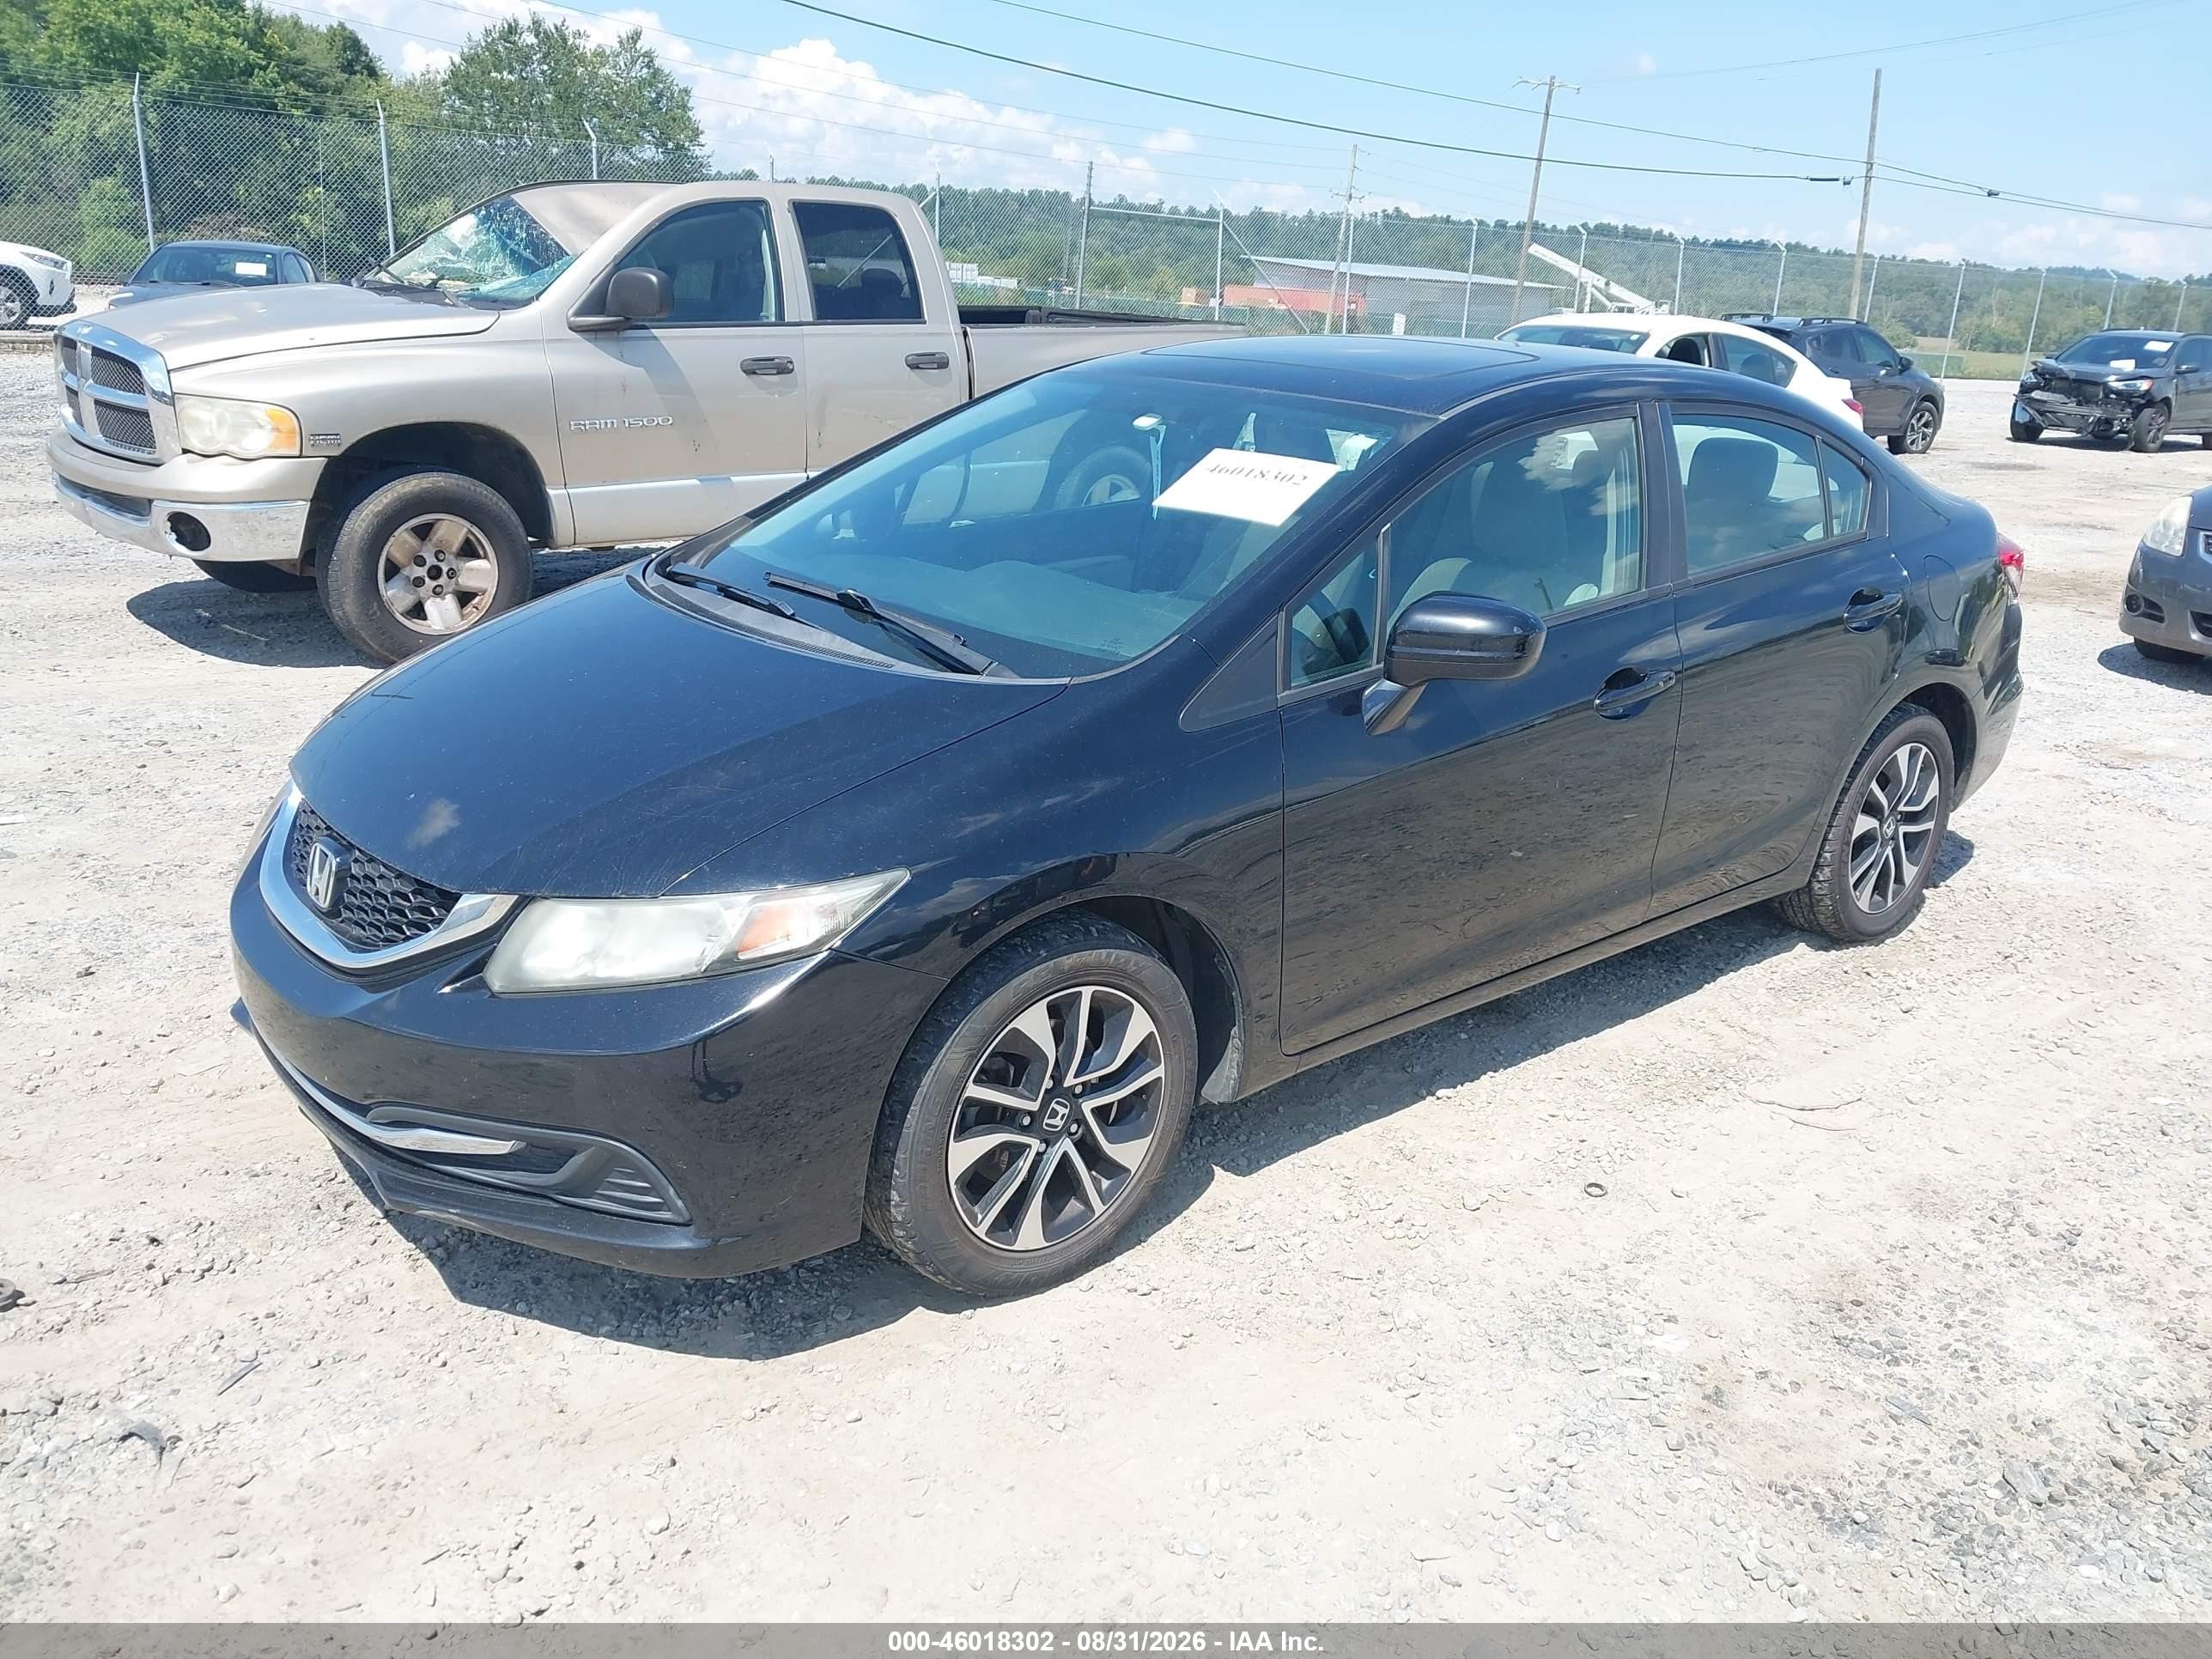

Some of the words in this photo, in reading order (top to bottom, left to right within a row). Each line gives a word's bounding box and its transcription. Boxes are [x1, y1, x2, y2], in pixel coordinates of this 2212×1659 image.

[570, 419, 617, 431] RAM
[623, 416, 673, 428] 1500
[1206, 463, 1307, 486] 46018302
